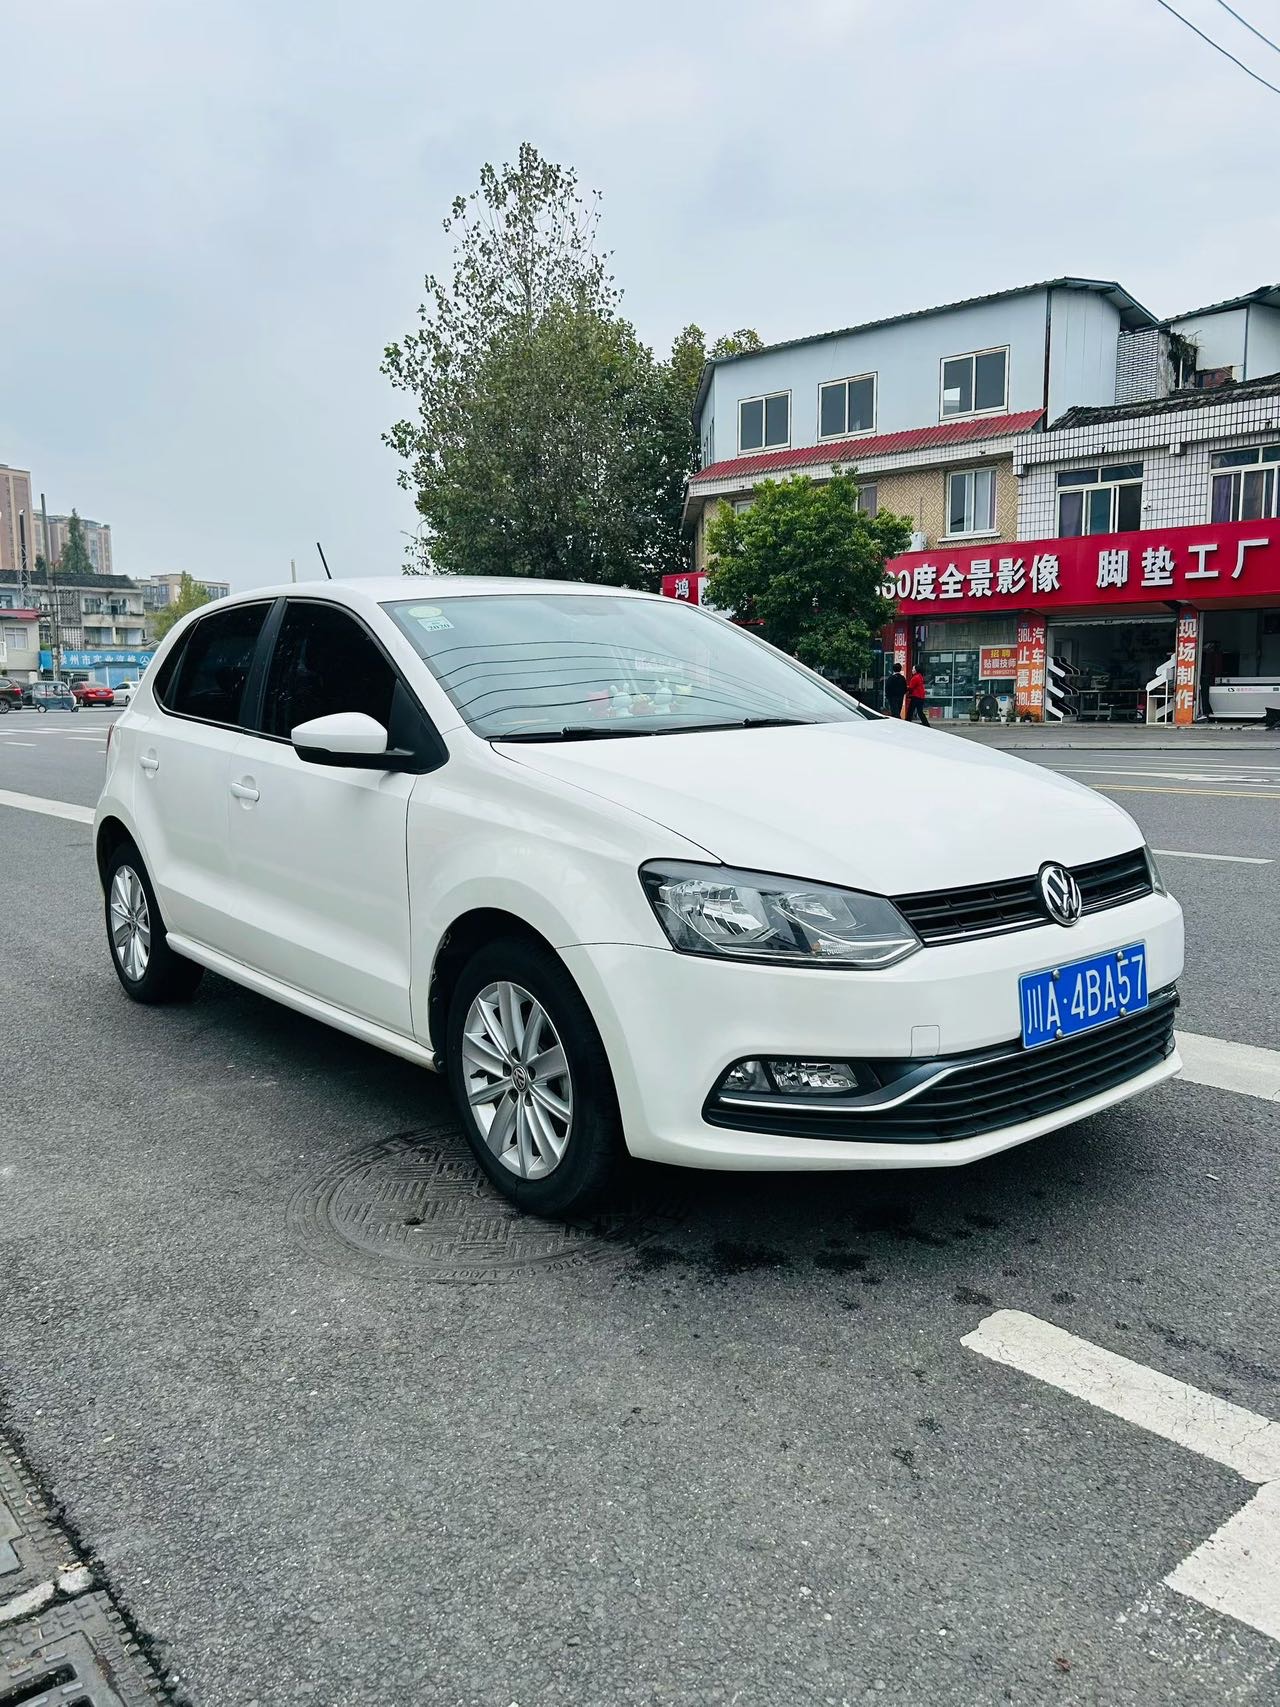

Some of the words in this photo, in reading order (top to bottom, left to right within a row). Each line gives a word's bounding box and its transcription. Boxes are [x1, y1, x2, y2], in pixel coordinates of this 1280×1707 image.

[674, 578, 690, 599] 鸿
[875, 553, 1061, 601] 60度全景影像
[1096, 538, 1270, 588] 脚垫工厂
[1030, 627, 1044, 706] 汽车脚垫
[1175, 619, 1198, 709] 现场制作
